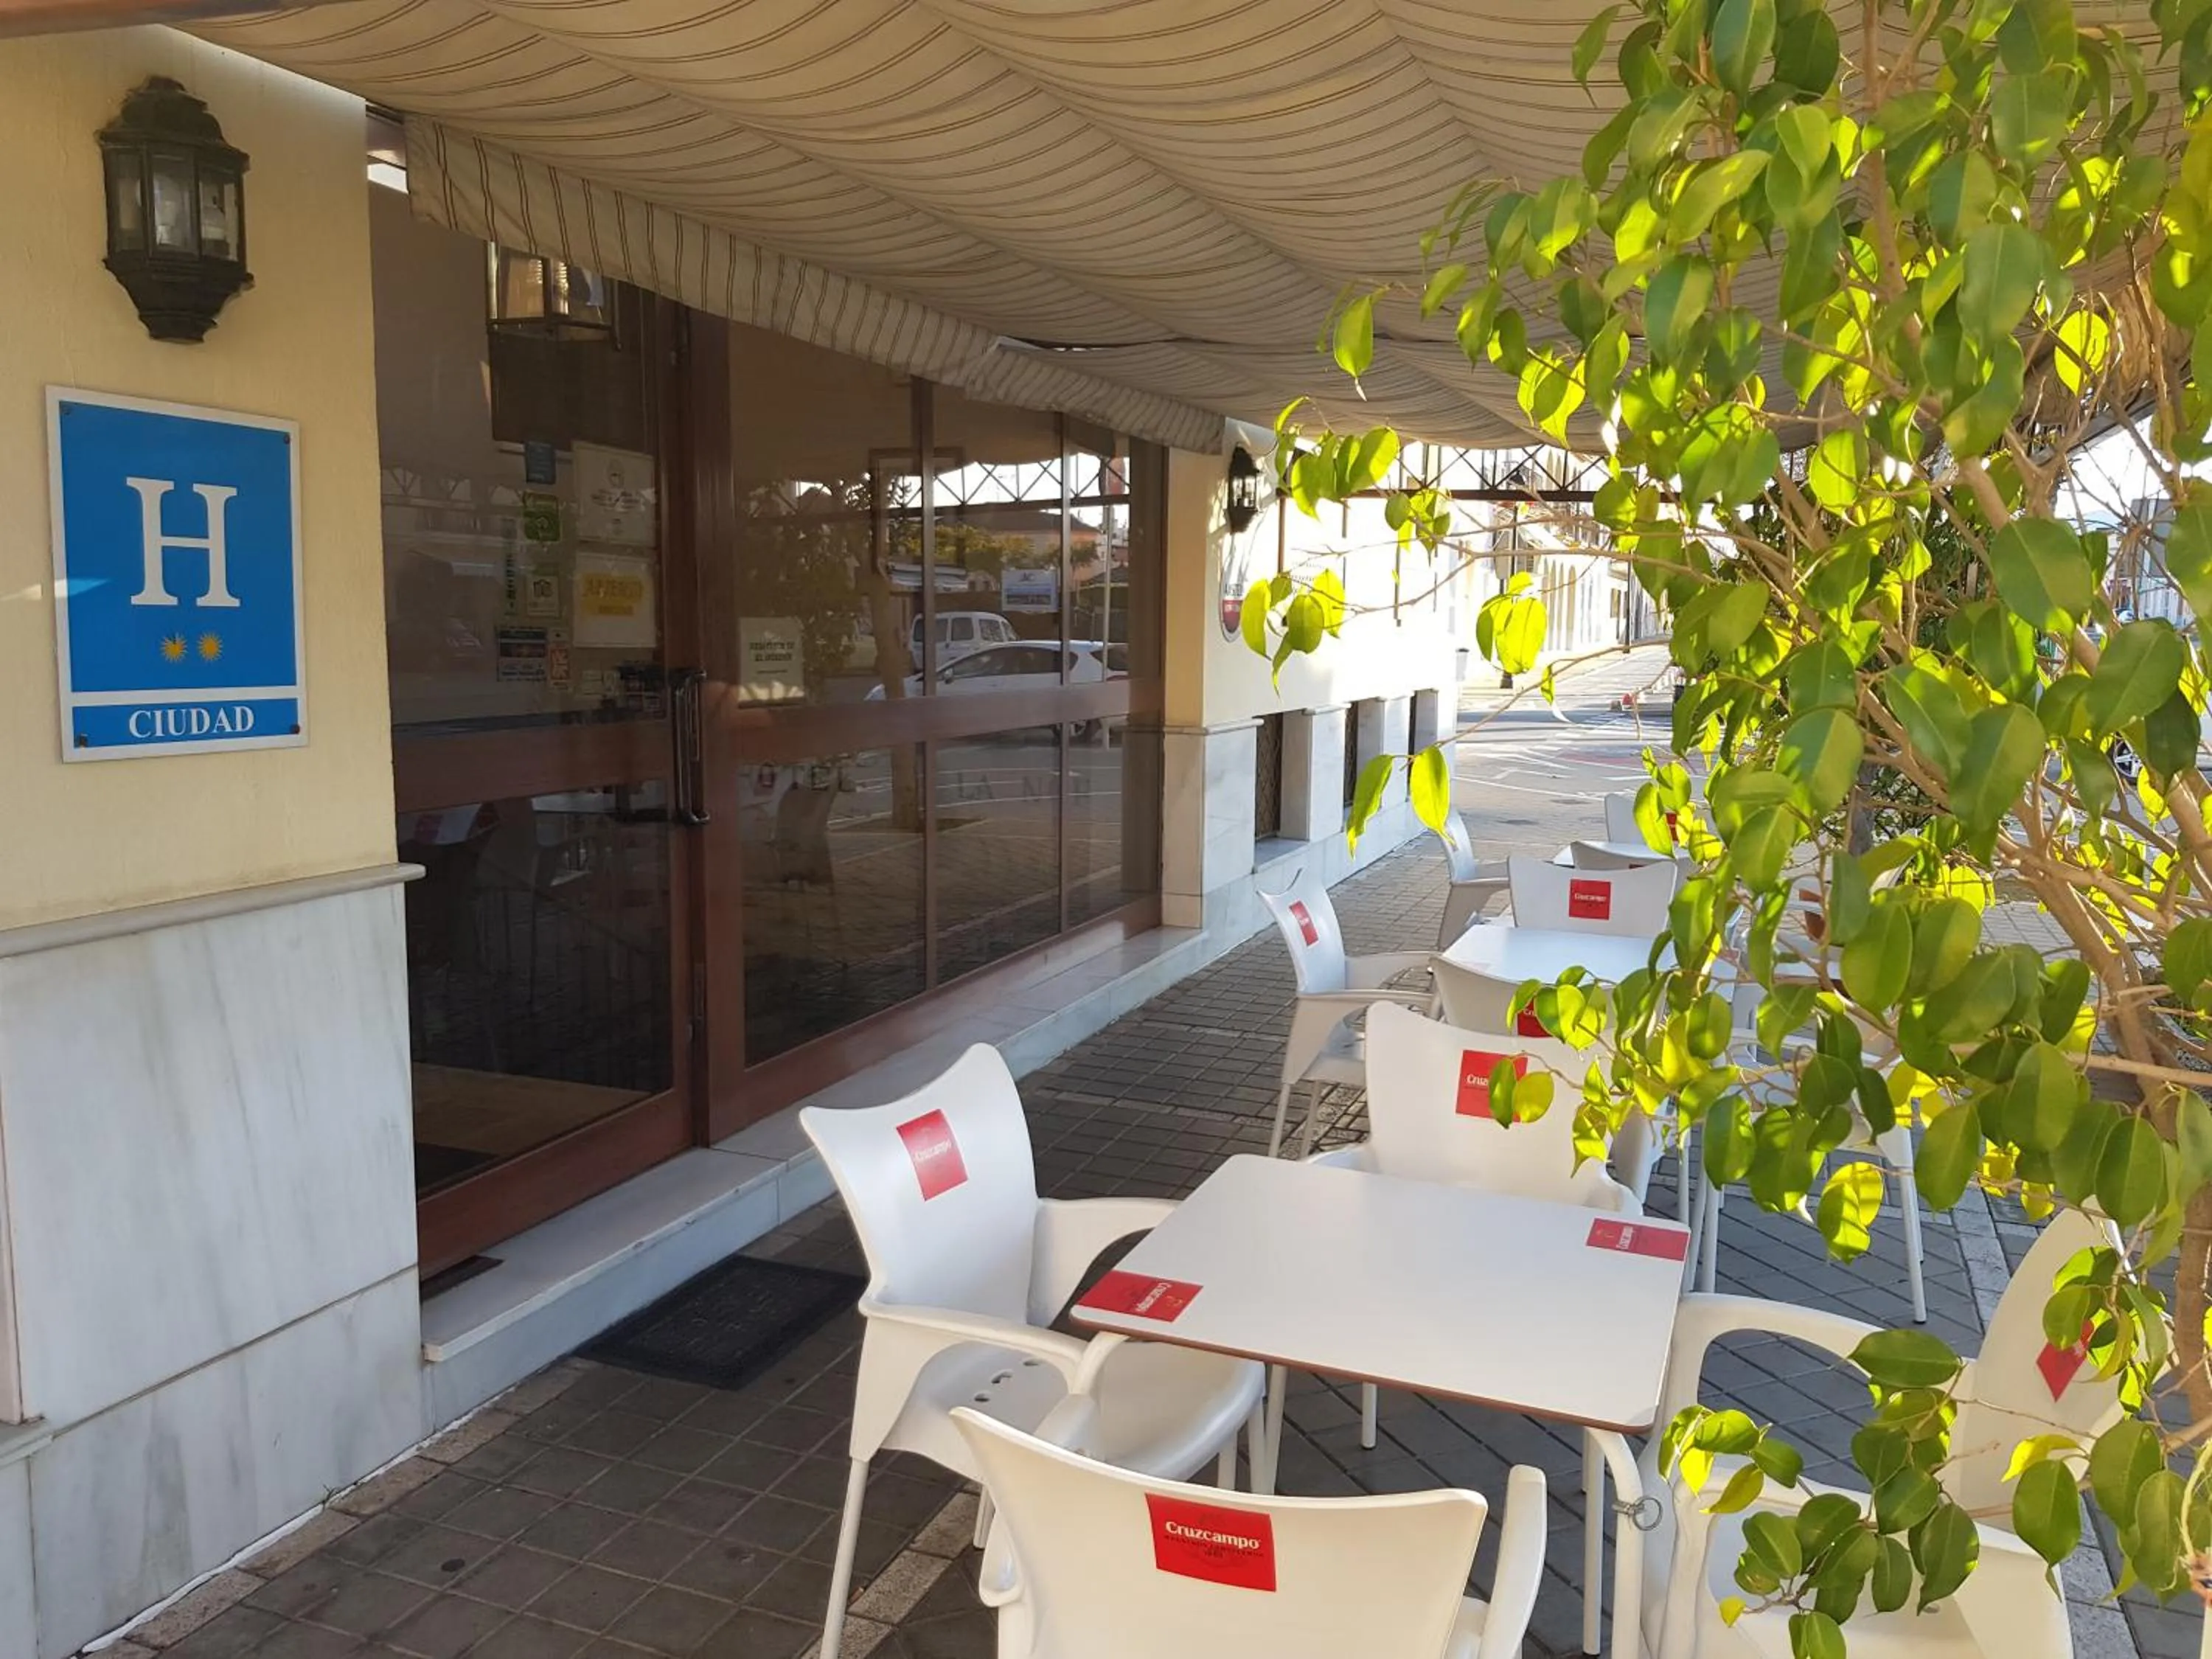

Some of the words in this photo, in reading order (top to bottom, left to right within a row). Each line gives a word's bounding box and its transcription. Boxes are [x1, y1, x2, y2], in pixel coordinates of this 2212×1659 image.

[126, 476, 241, 607] H
[128, 705, 255, 738] CIUDAD
[1165, 1521, 1260, 1550] Cruzcampo
